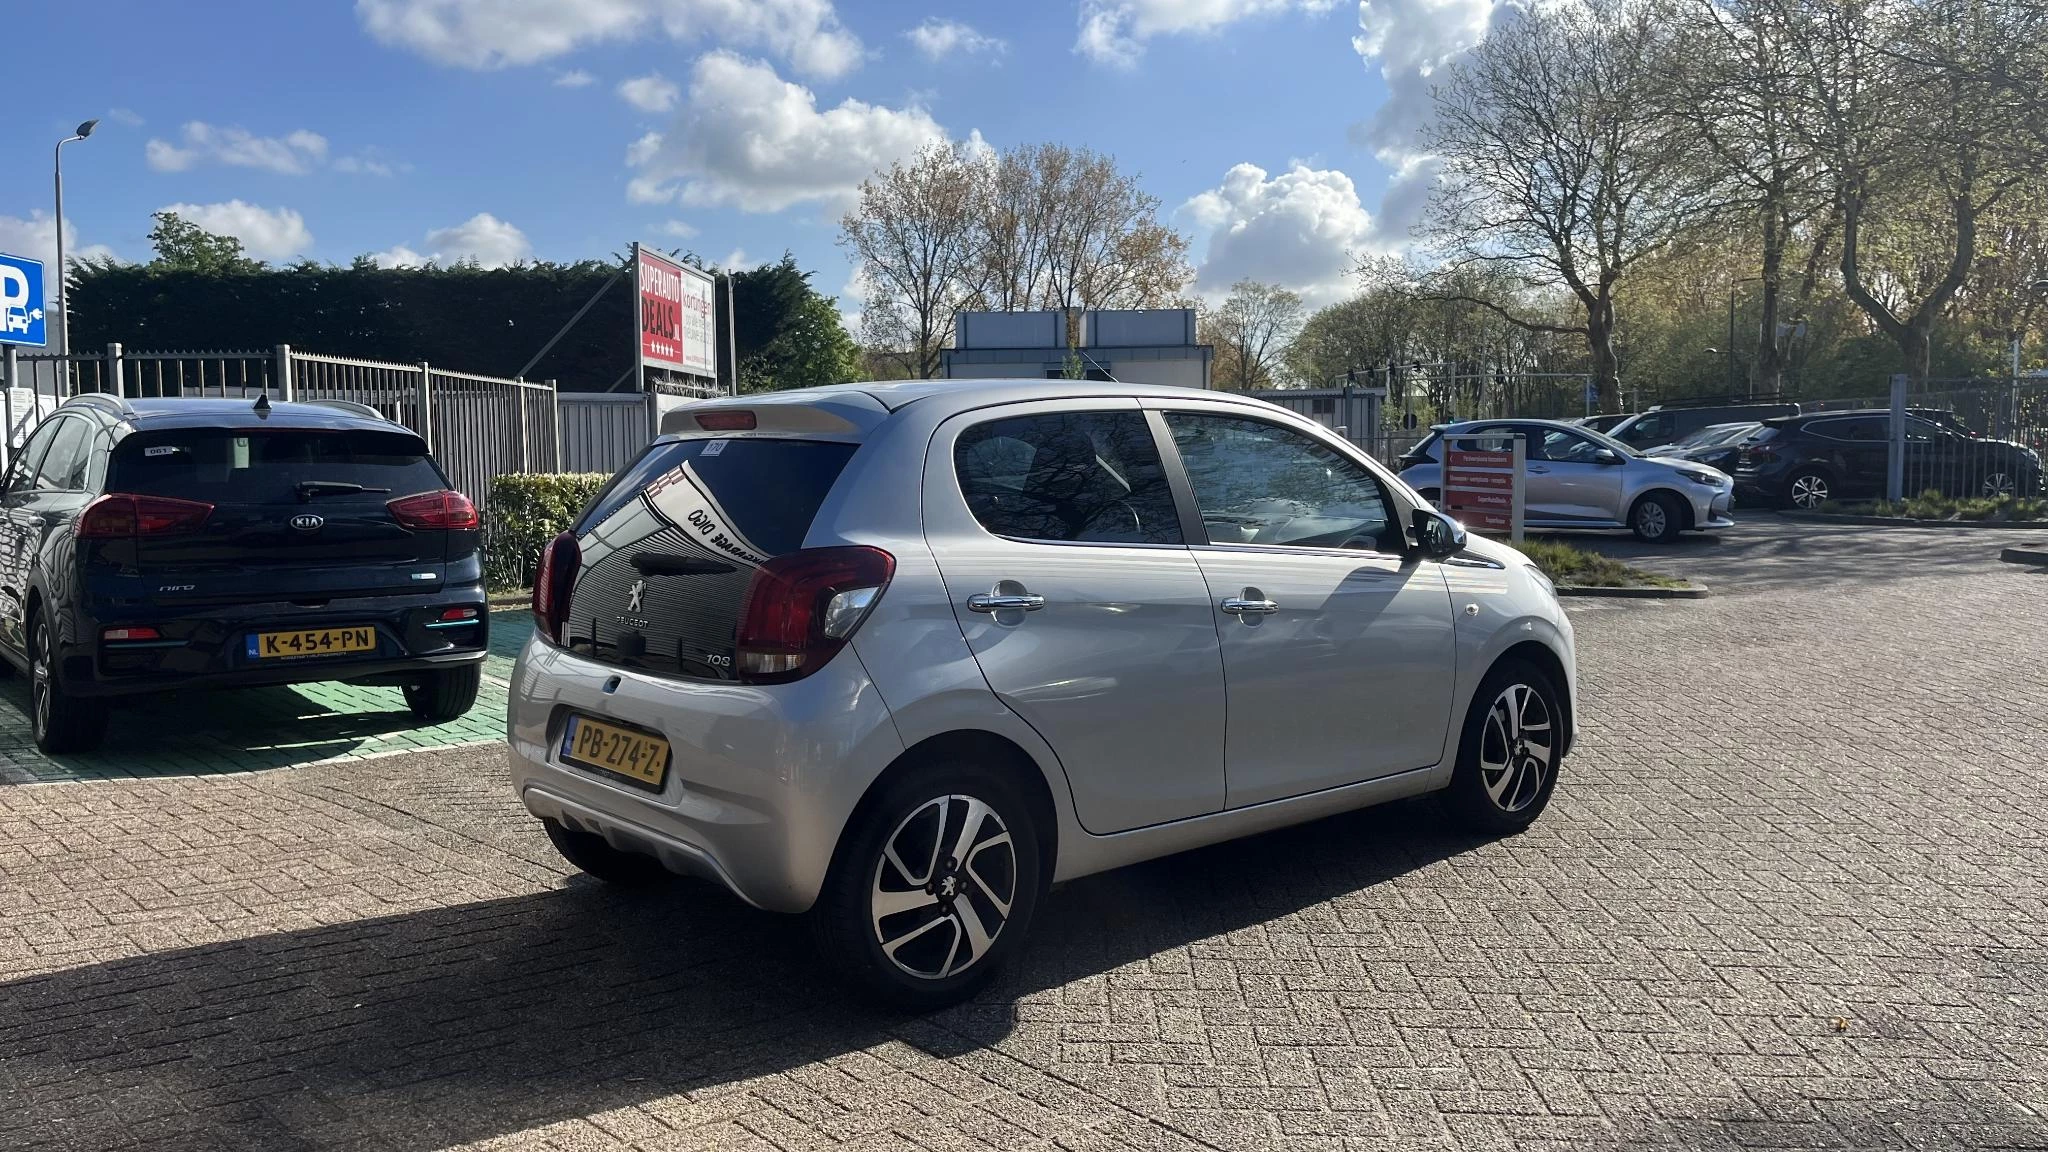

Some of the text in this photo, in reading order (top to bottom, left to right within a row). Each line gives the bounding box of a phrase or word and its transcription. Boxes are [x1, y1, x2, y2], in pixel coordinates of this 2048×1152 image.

[640, 261, 679, 303] SUPERAUTO
[0, 264, 29, 331] P
[296, 517, 319, 527] KIA
[616, 616, 648, 628] PEUGEOT
[265, 629, 369, 654] K-454-PN
[706, 654, 731, 667] 108
[578, 725, 660, 776] PB-274-Z
